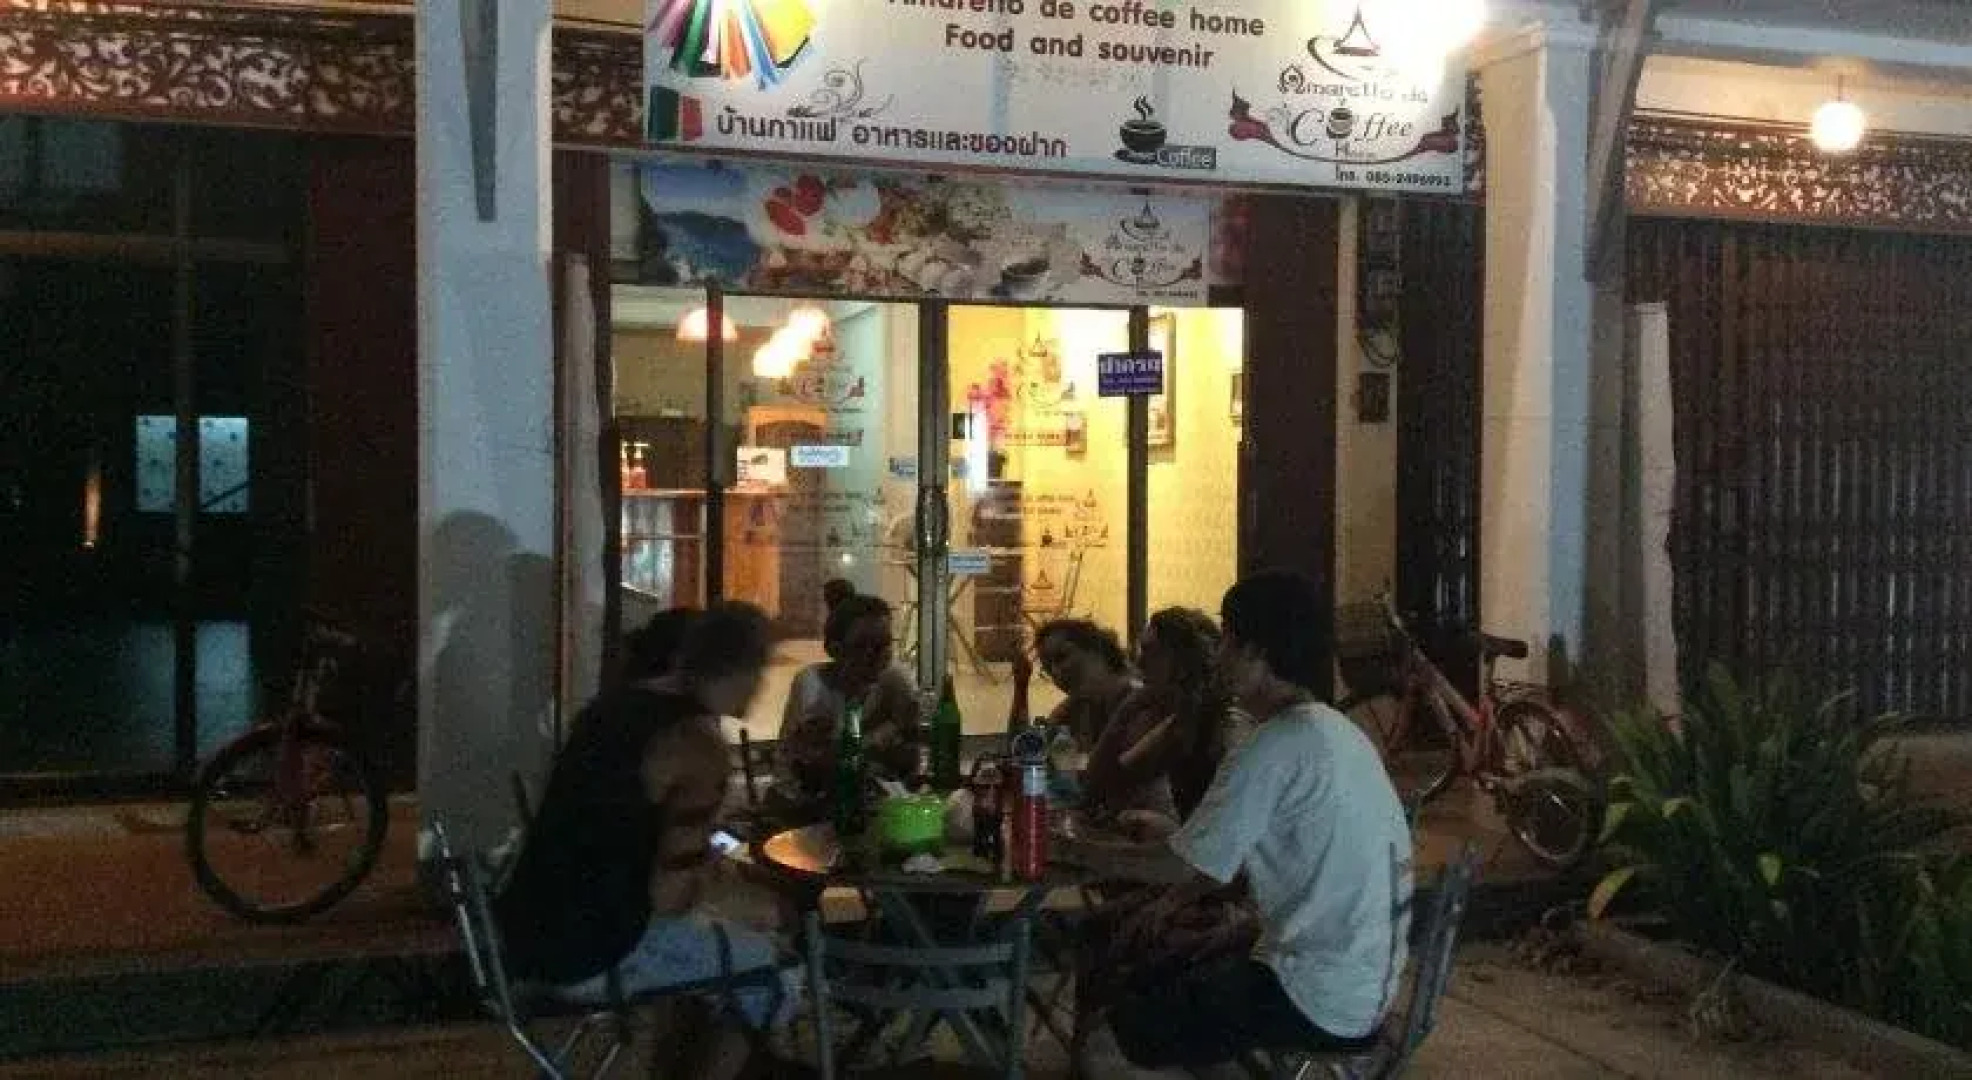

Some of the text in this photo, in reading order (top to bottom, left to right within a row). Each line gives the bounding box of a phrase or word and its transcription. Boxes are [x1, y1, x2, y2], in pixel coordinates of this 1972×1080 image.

[1040, 0, 1074, 19] de
[1089, 1, 1174, 28] coffee
[1189, 7, 1264, 36] home
[945, 23, 1214, 68] Food and souvenir
